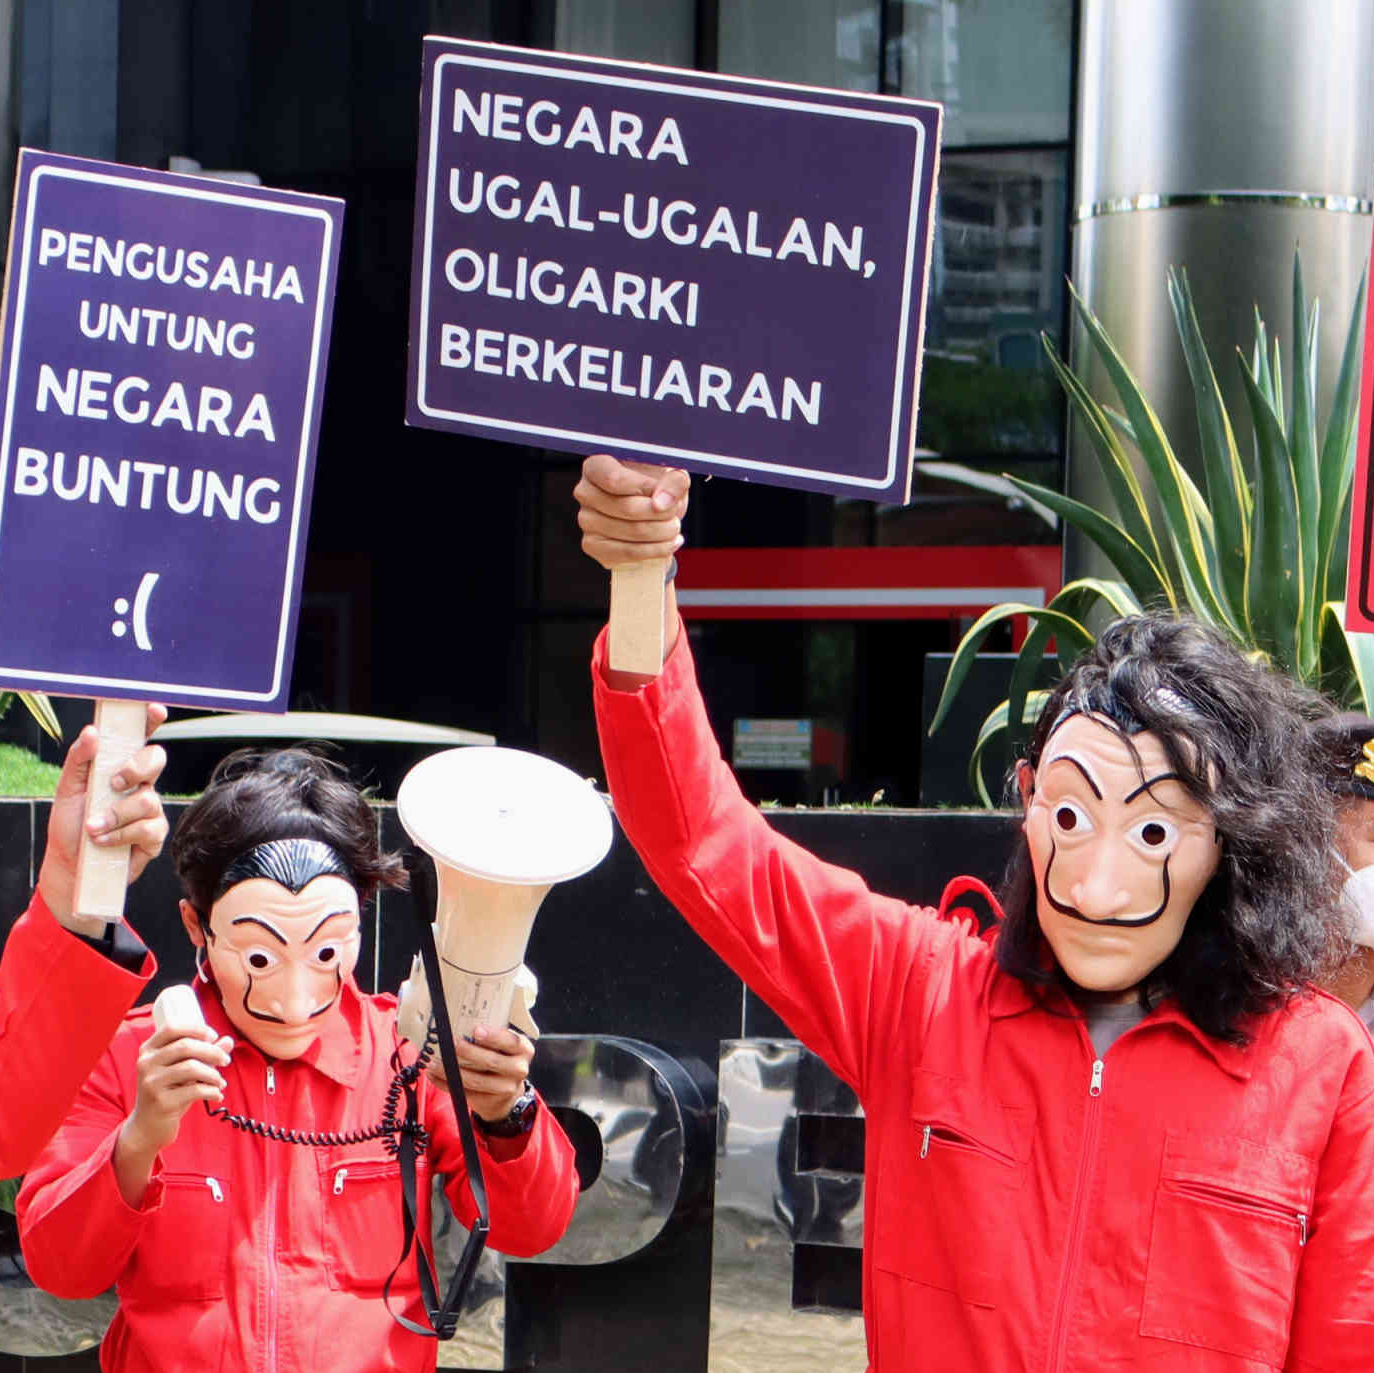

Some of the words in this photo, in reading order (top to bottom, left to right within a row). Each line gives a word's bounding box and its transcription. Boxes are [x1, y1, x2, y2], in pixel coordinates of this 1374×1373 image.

[452, 88, 689, 166] NEGARA
[449, 167, 876, 279] UGAL-UGALAN,
[38, 227, 305, 305] PENGUSAHA
[444, 248, 699, 327] OLIGARKI
[79, 299, 256, 360] UNTUNG
[35, 363, 276, 443] NEGARA
[440, 323, 822, 425] BERKELIARAN
[13, 446, 281, 525] BUNTUNG
